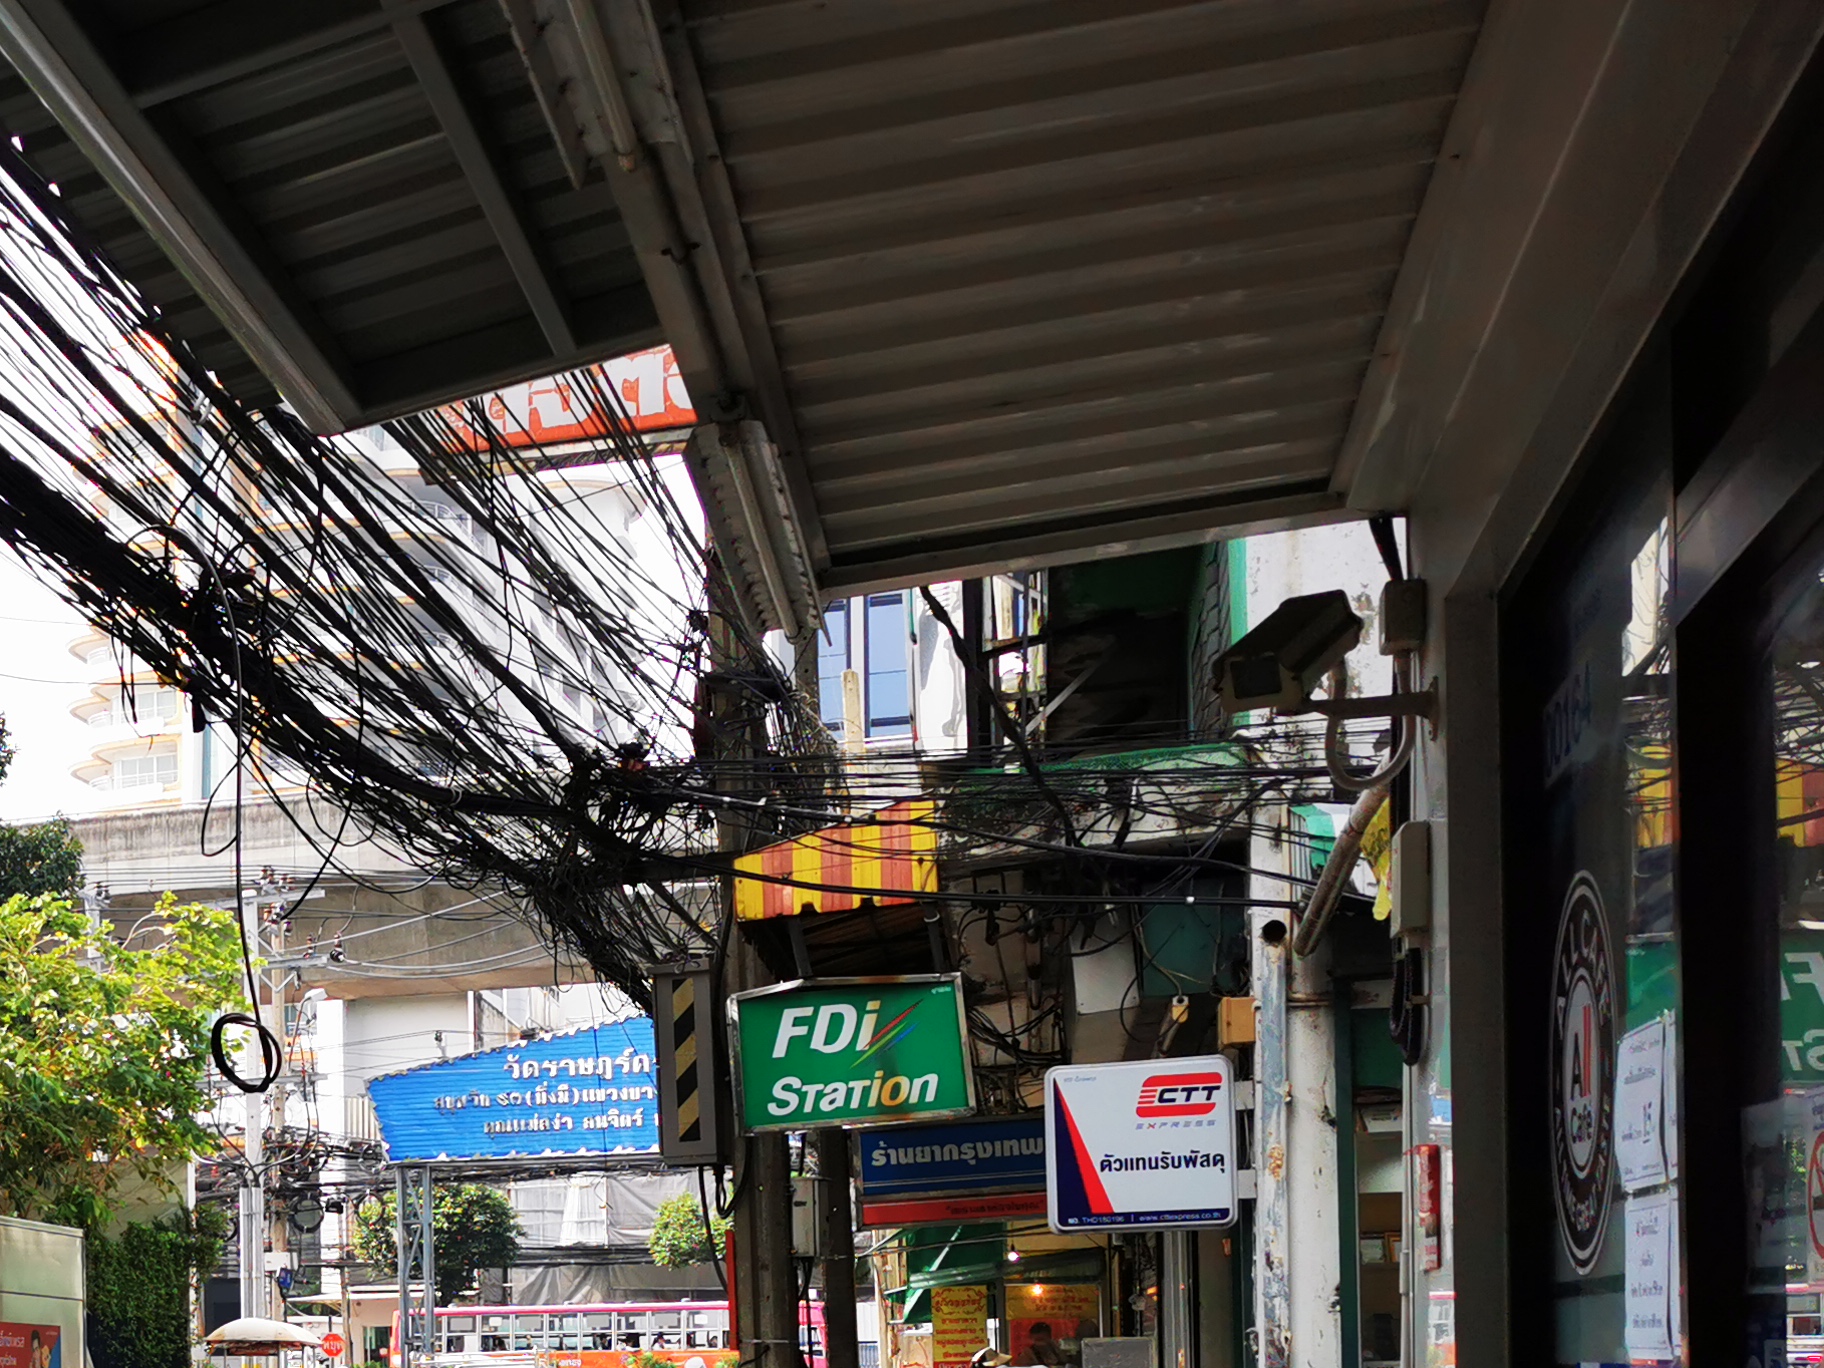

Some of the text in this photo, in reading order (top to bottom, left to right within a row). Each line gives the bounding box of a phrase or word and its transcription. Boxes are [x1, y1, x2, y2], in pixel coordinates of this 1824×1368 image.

[772, 1000, 881, 1058] FDi
[503, 1047, 658, 1080] วัดราษฎร์ศ
[1157, 1085, 1222, 1104] CTT
[1135, 1119, 1217, 1130] EXPRESS
[1100, 1149, 1226, 1174] ตัวแทนรับพัสดุ
